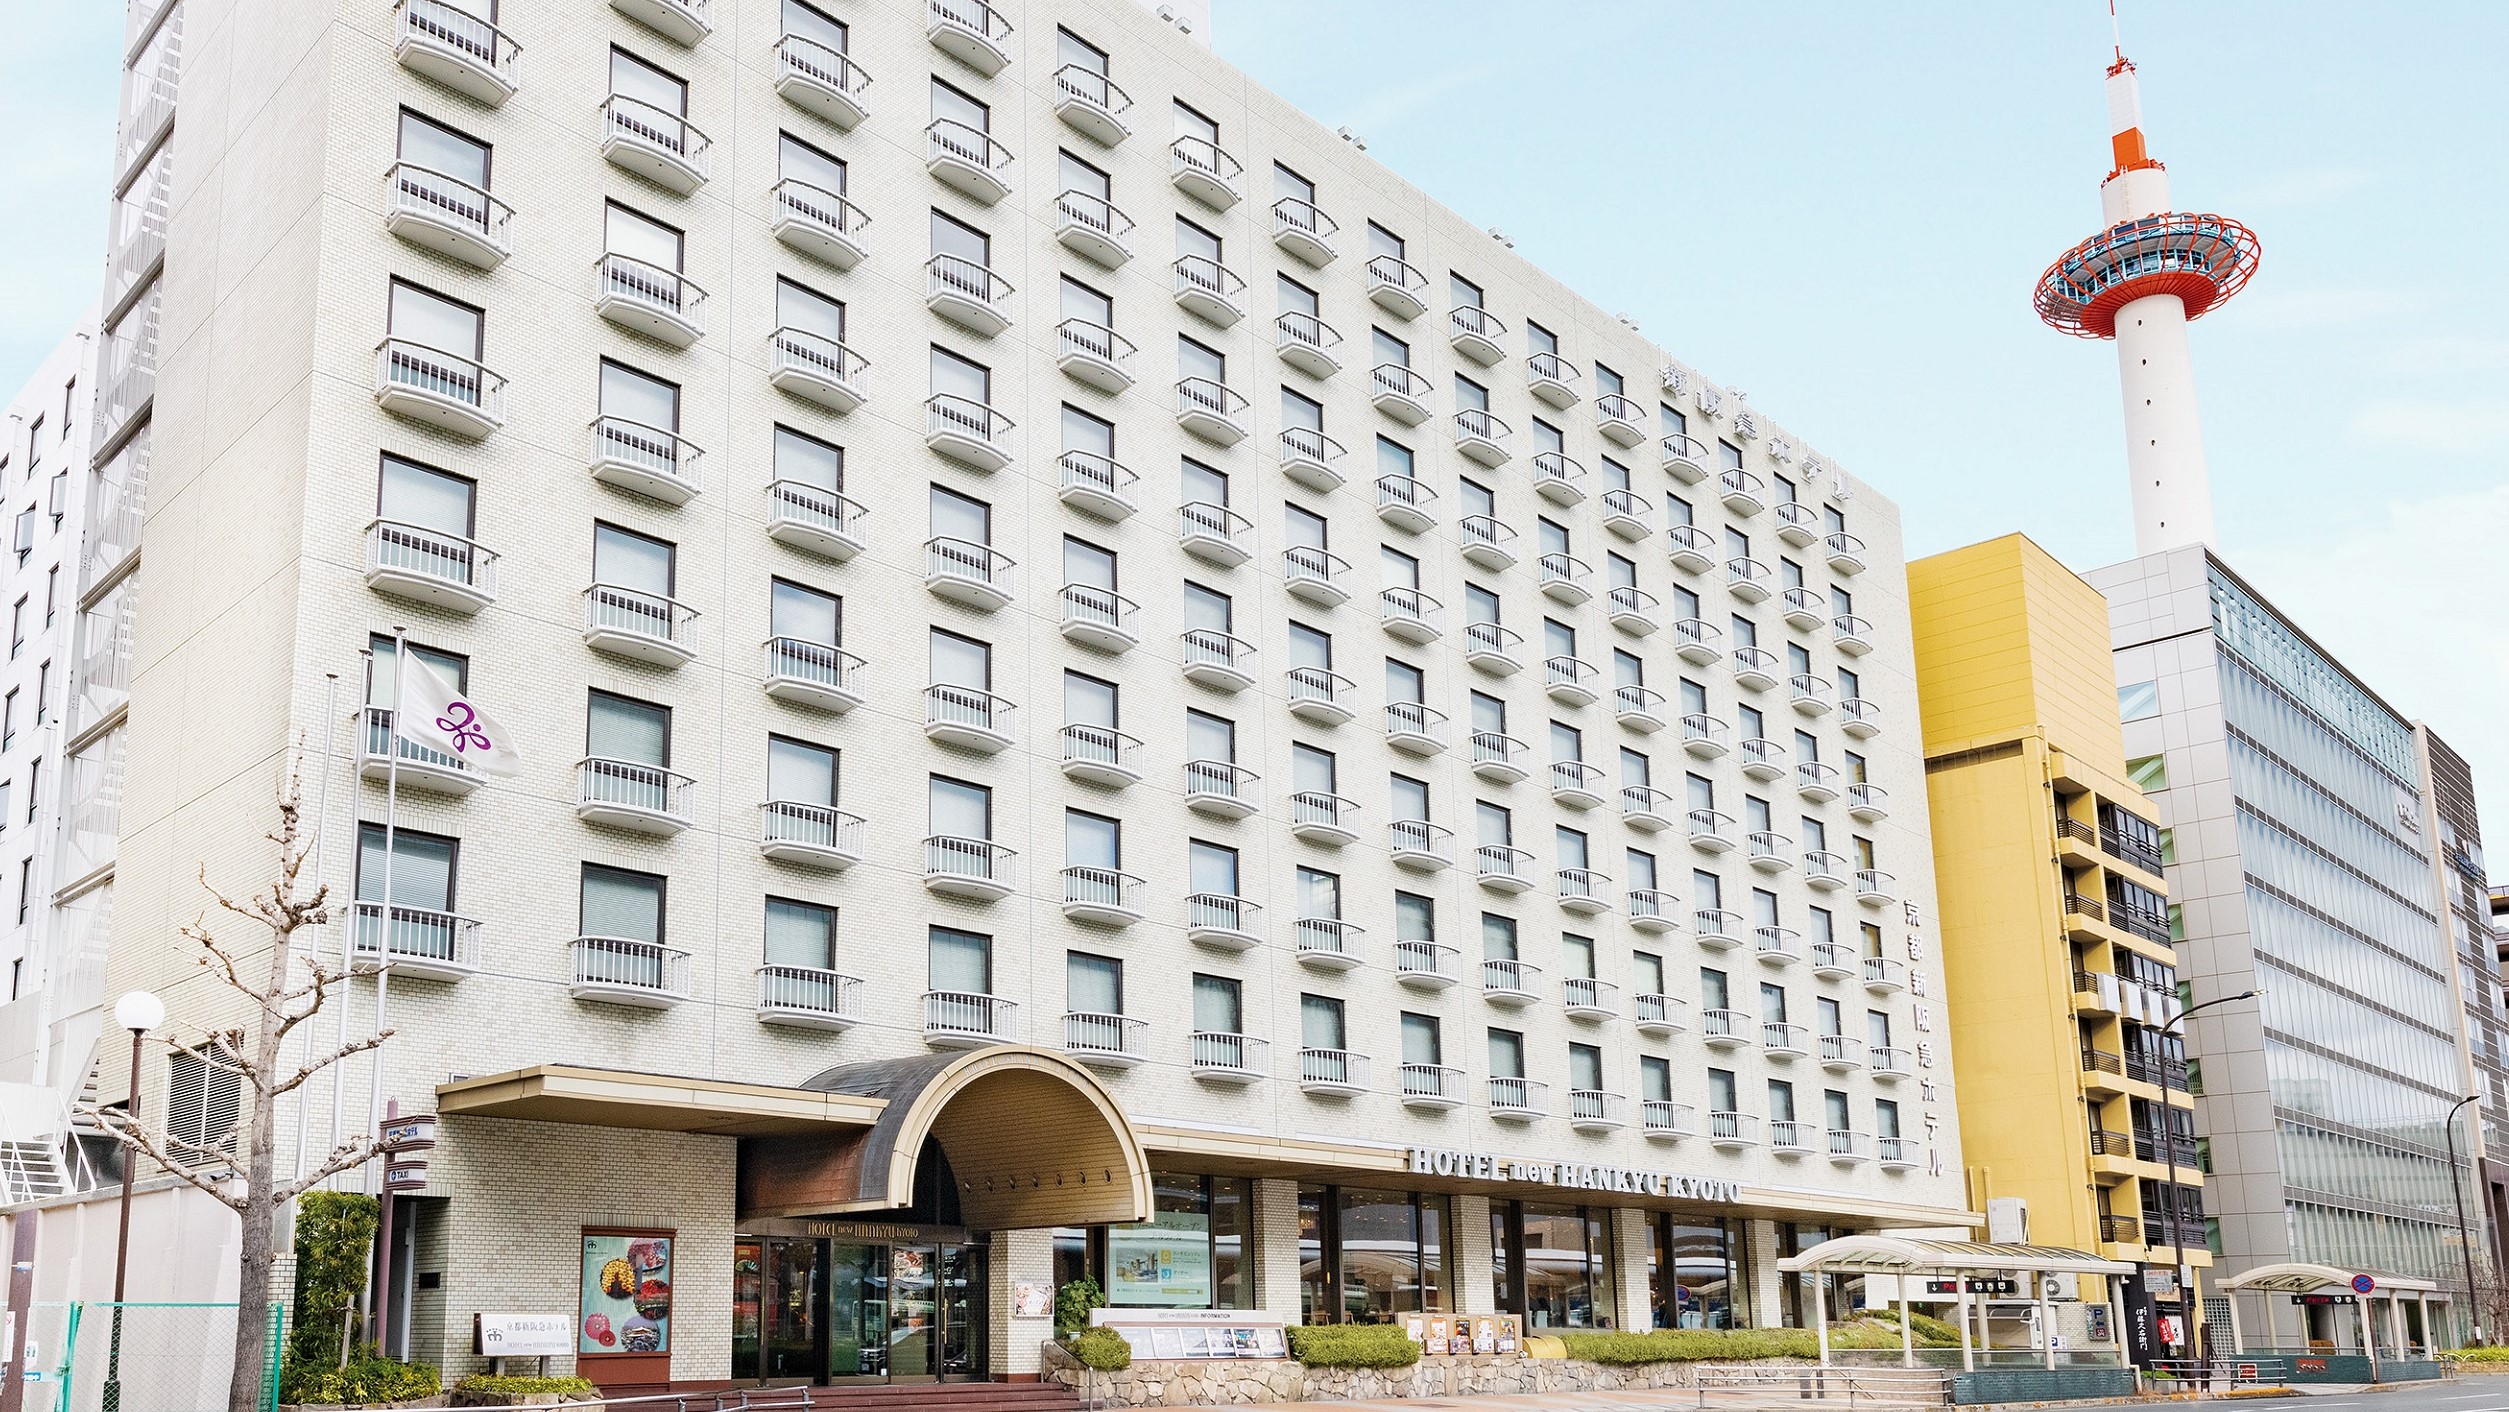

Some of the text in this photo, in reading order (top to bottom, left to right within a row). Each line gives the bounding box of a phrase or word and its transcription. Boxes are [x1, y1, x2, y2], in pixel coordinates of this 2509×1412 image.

[1904, 898, 1943, 1177] 京都新阪急ホテル
[397, 1170, 409, 1179] TAXI
[1408, 1146, 1742, 1203] HOTEL new HANKYU KYOTO
[808, 1222, 835, 1236] HOTEL
[2093, 1309, 2103, 1319] P
